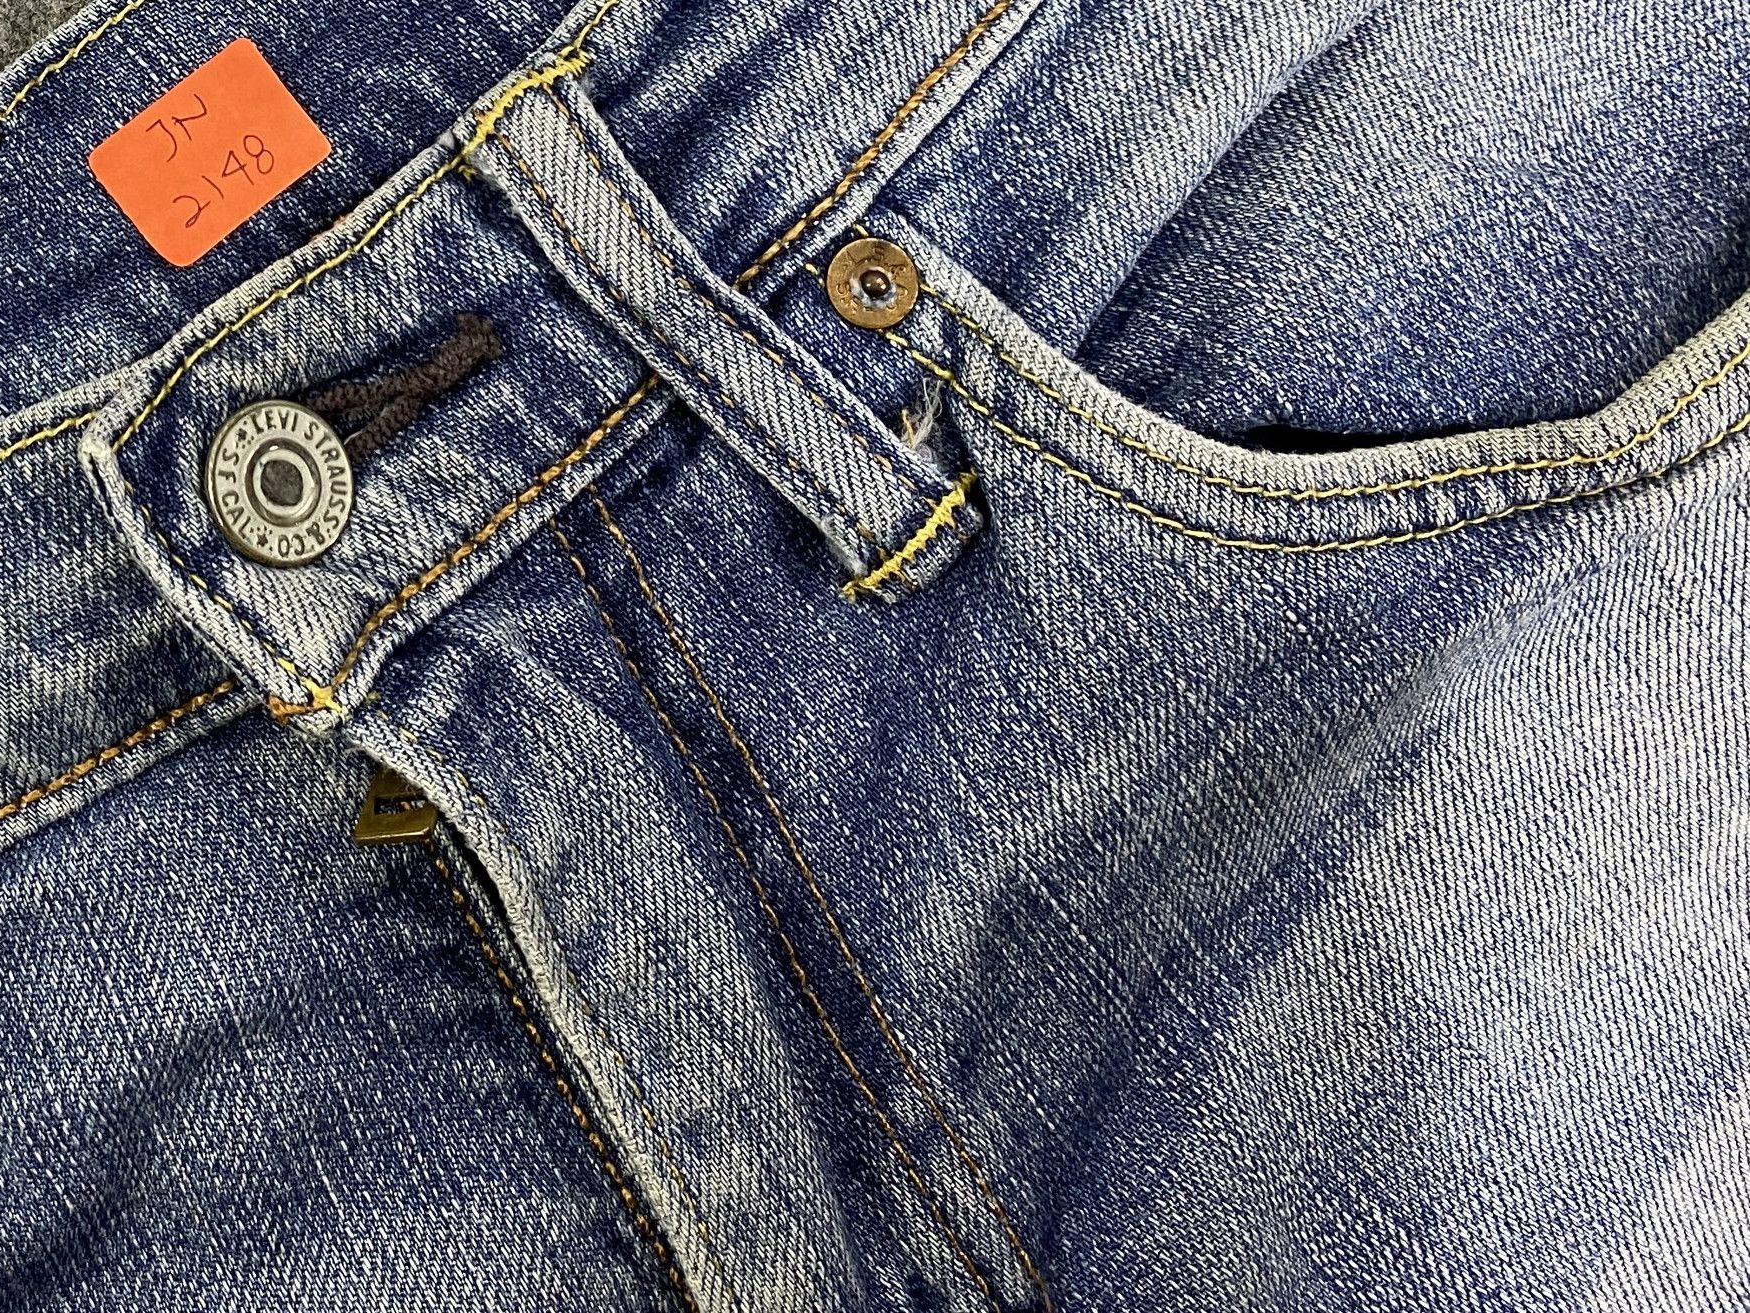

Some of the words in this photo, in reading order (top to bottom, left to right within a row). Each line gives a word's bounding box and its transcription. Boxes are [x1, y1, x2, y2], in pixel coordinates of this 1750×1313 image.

[146, 94, 207, 162] JN
[173, 135, 274, 227] 2148
[249, 410, 298, 434] LEVI
[304, 421, 348, 529] STRAUSS
[222, 491, 251, 539] CAL
